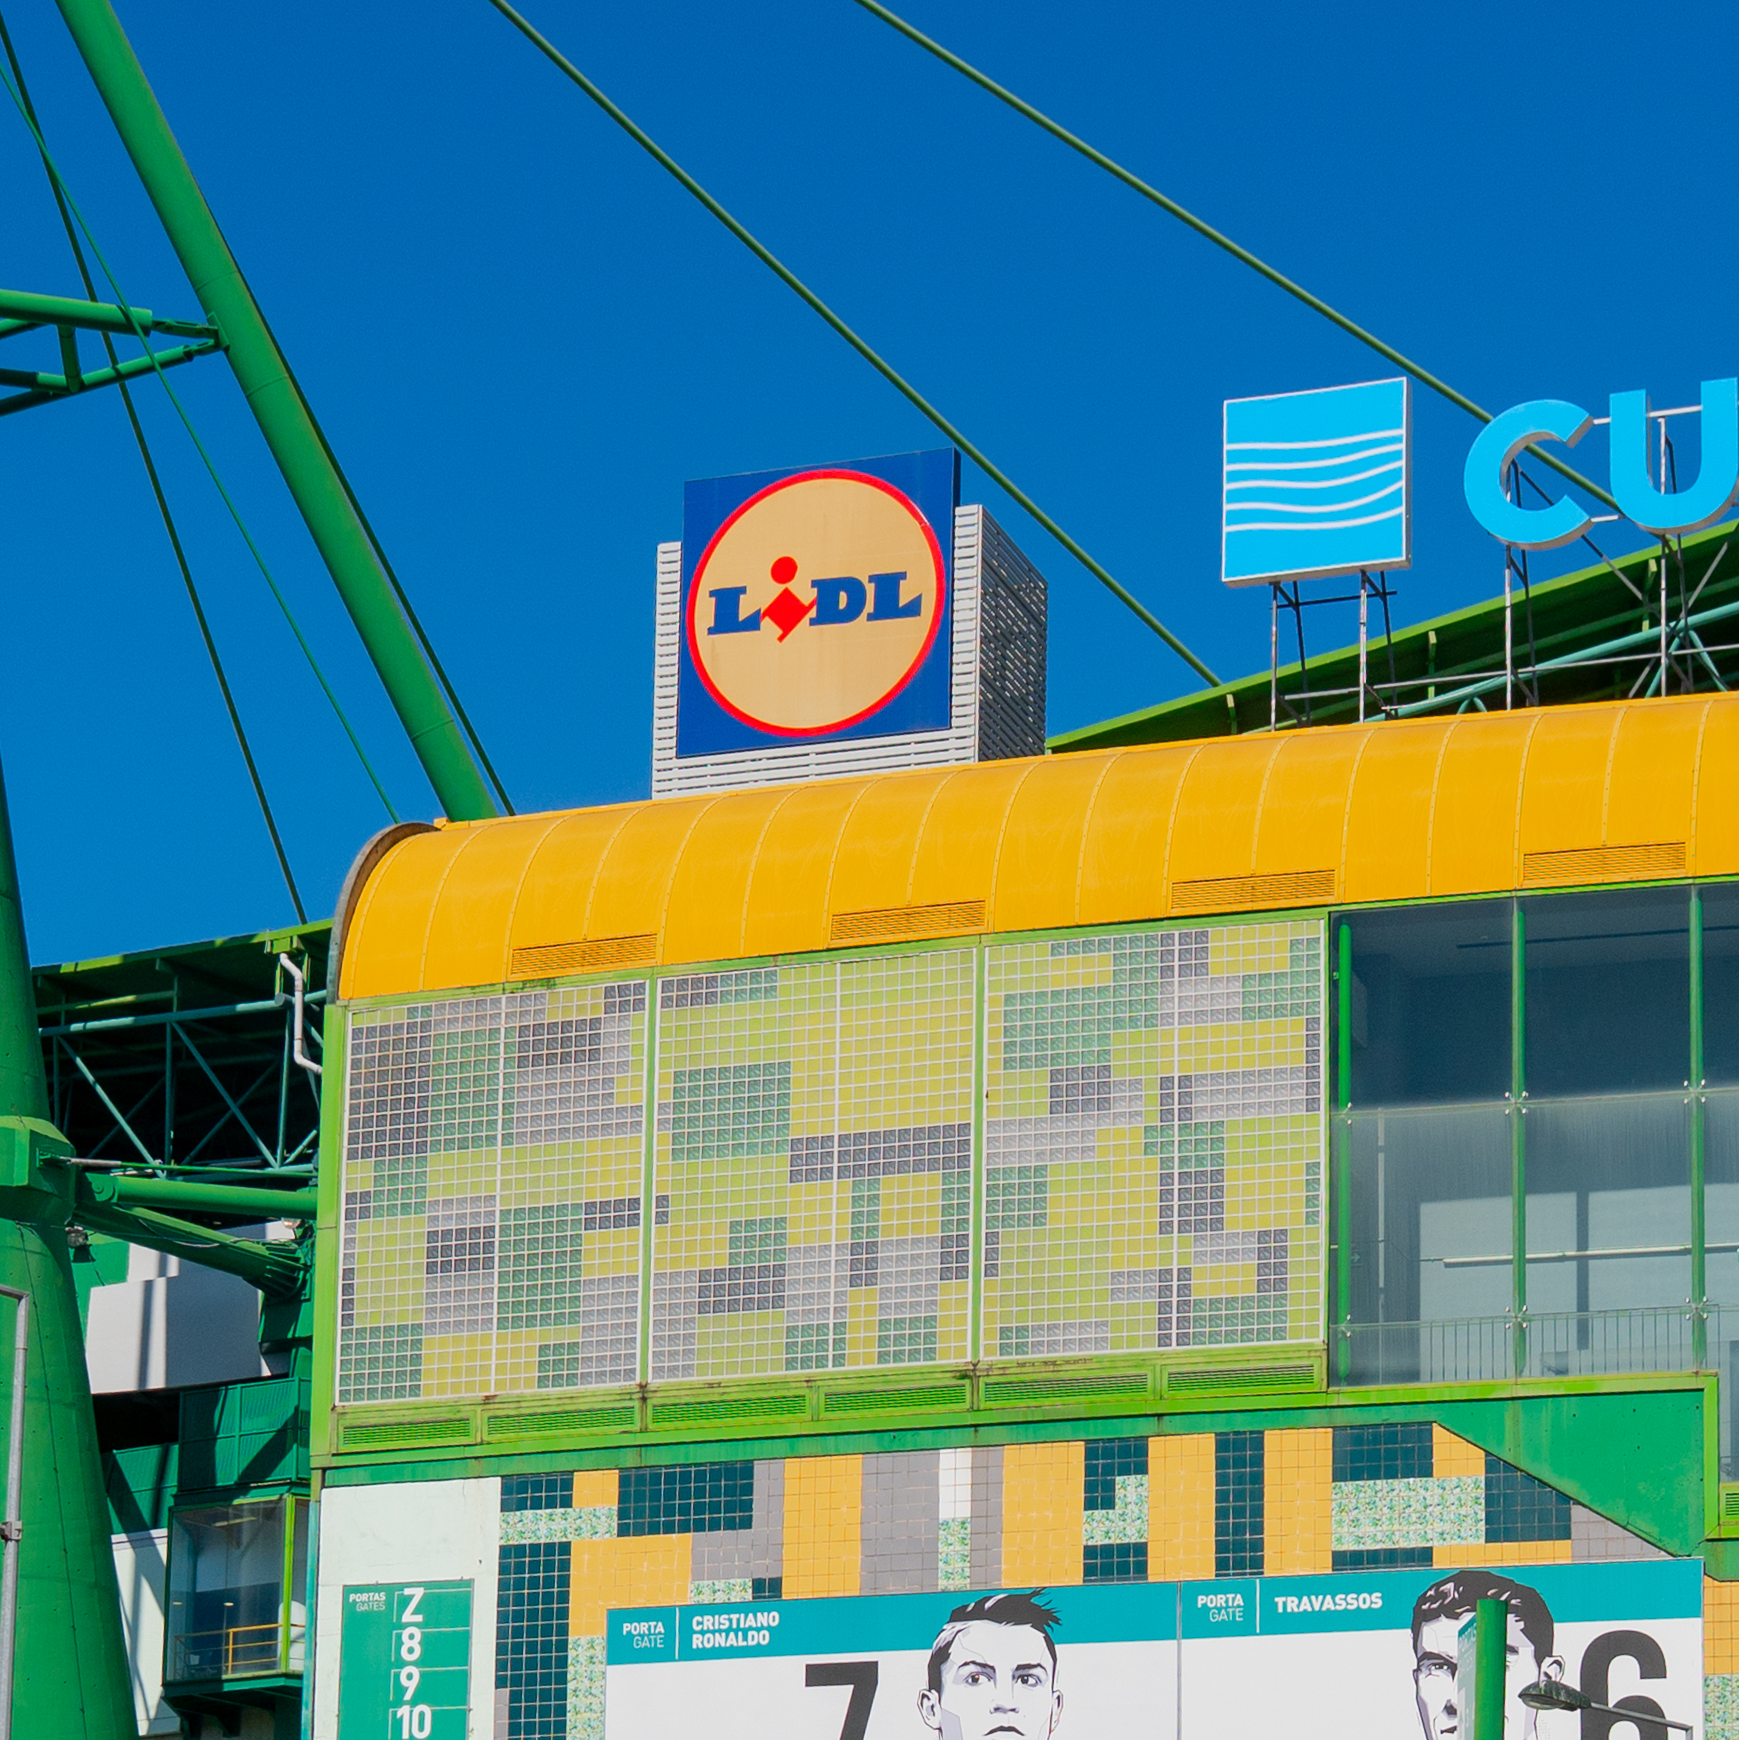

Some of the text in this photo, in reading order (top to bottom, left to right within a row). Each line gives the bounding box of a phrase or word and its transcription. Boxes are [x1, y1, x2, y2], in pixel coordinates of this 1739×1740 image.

[349, 1592, 386, 1602] PORTAS
[356, 1602, 386, 1611] GATES
[401, 1587, 425, 1623] Z
[1197, 1593, 1244, 1608] PORTA
[1274, 1592, 1383, 1613] TRAVASSOS
[692, 1611, 780, 1631] CRISTIANO
[1209, 1607, 1244, 1622] GATE
[622, 1621, 665, 1636] PORTA
[400, 1626, 422, 1661] 8
[633, 1635, 665, 1649] GATE
[692, 1630, 770, 1649] RONALDO
[399, 1665, 420, 1701] 9
[396, 1704, 432, 1740] 10
